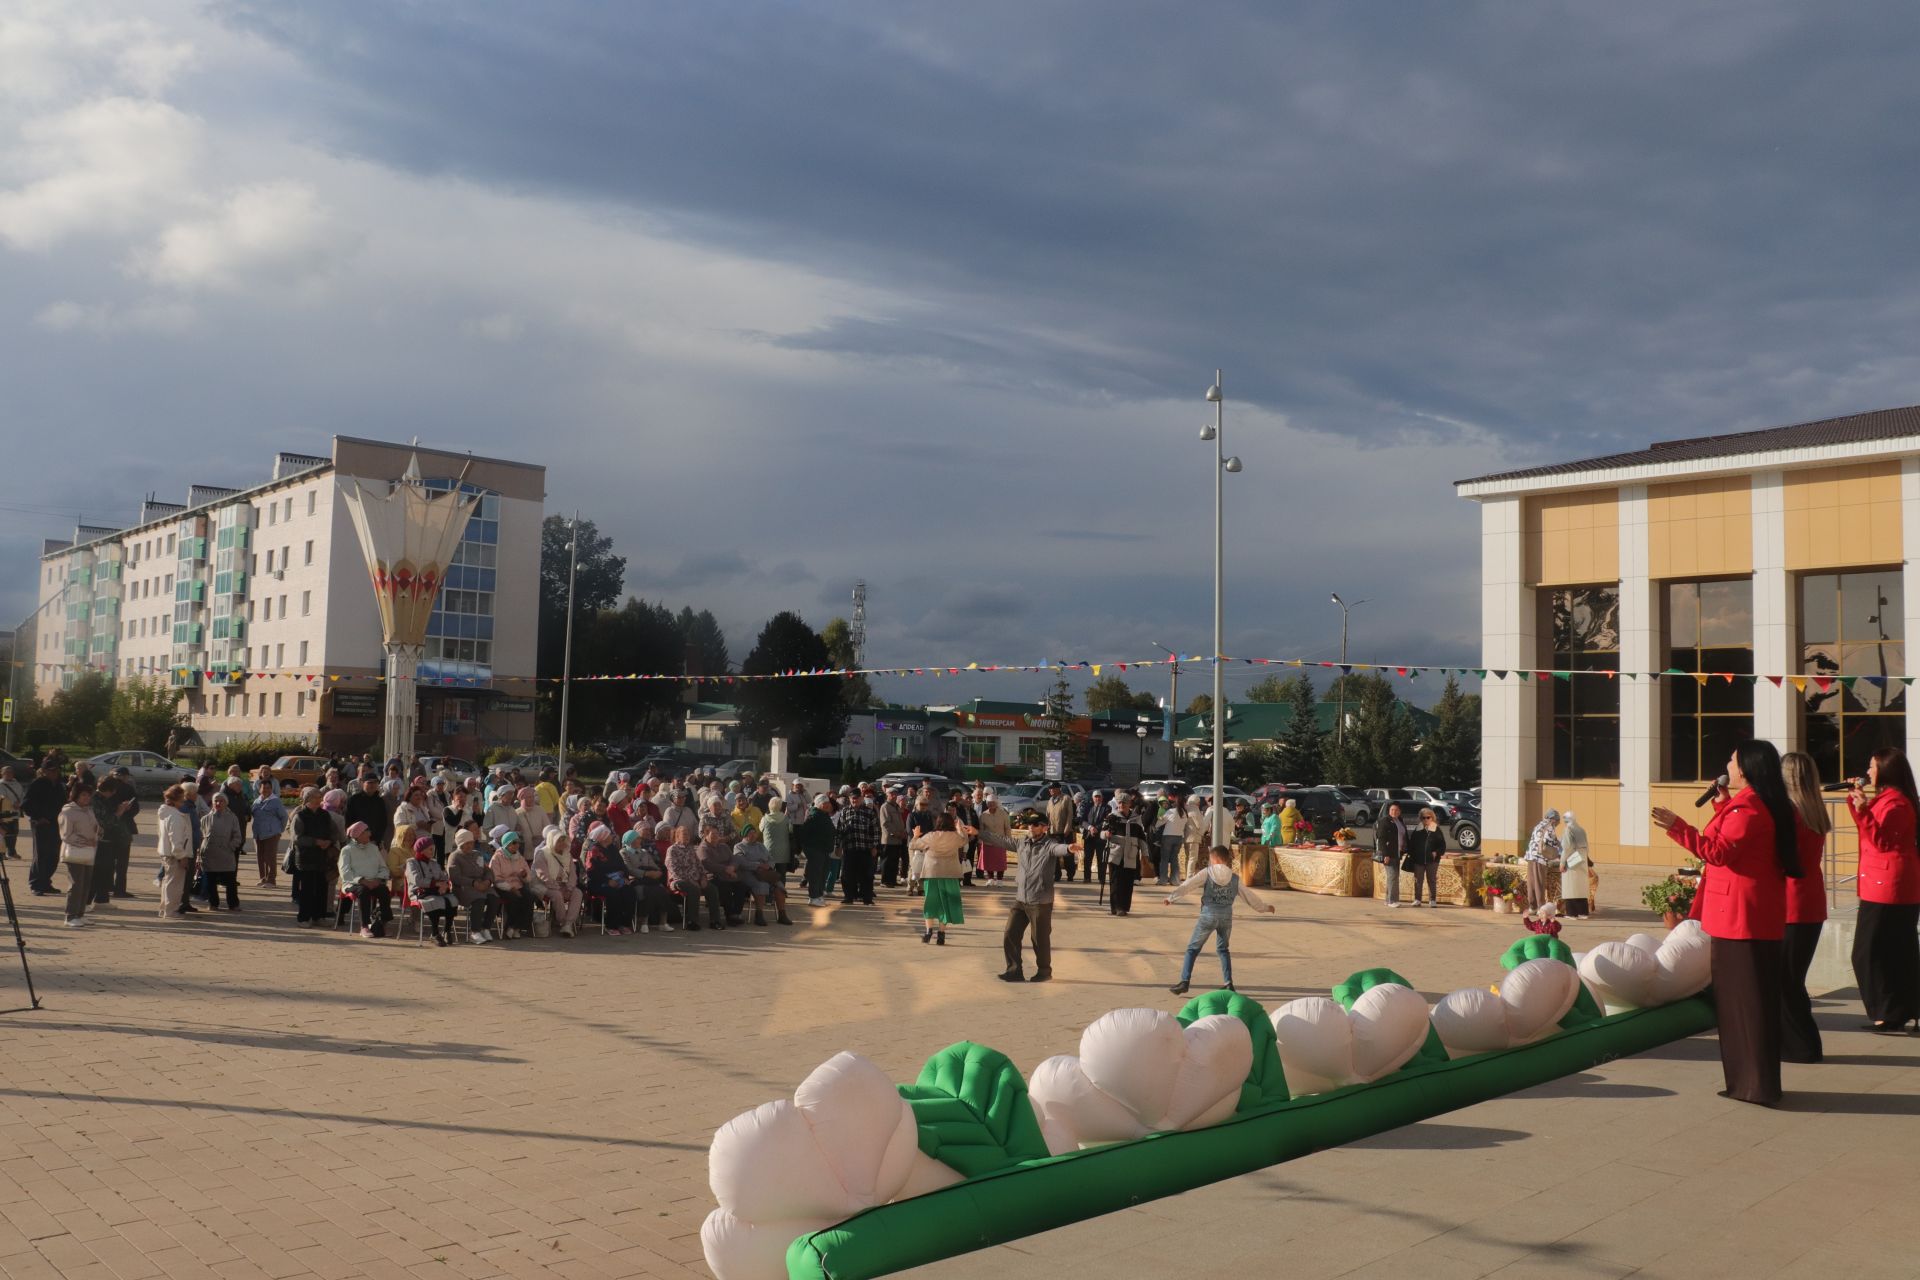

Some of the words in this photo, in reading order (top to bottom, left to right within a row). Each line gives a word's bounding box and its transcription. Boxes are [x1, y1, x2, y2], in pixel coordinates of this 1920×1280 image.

[898, 722, 925, 731] АПРЕЛЬ
[979, 719, 1016, 728] УНИВЕРСАМ
[1029, 719, 1064, 729] МОНЕТ
